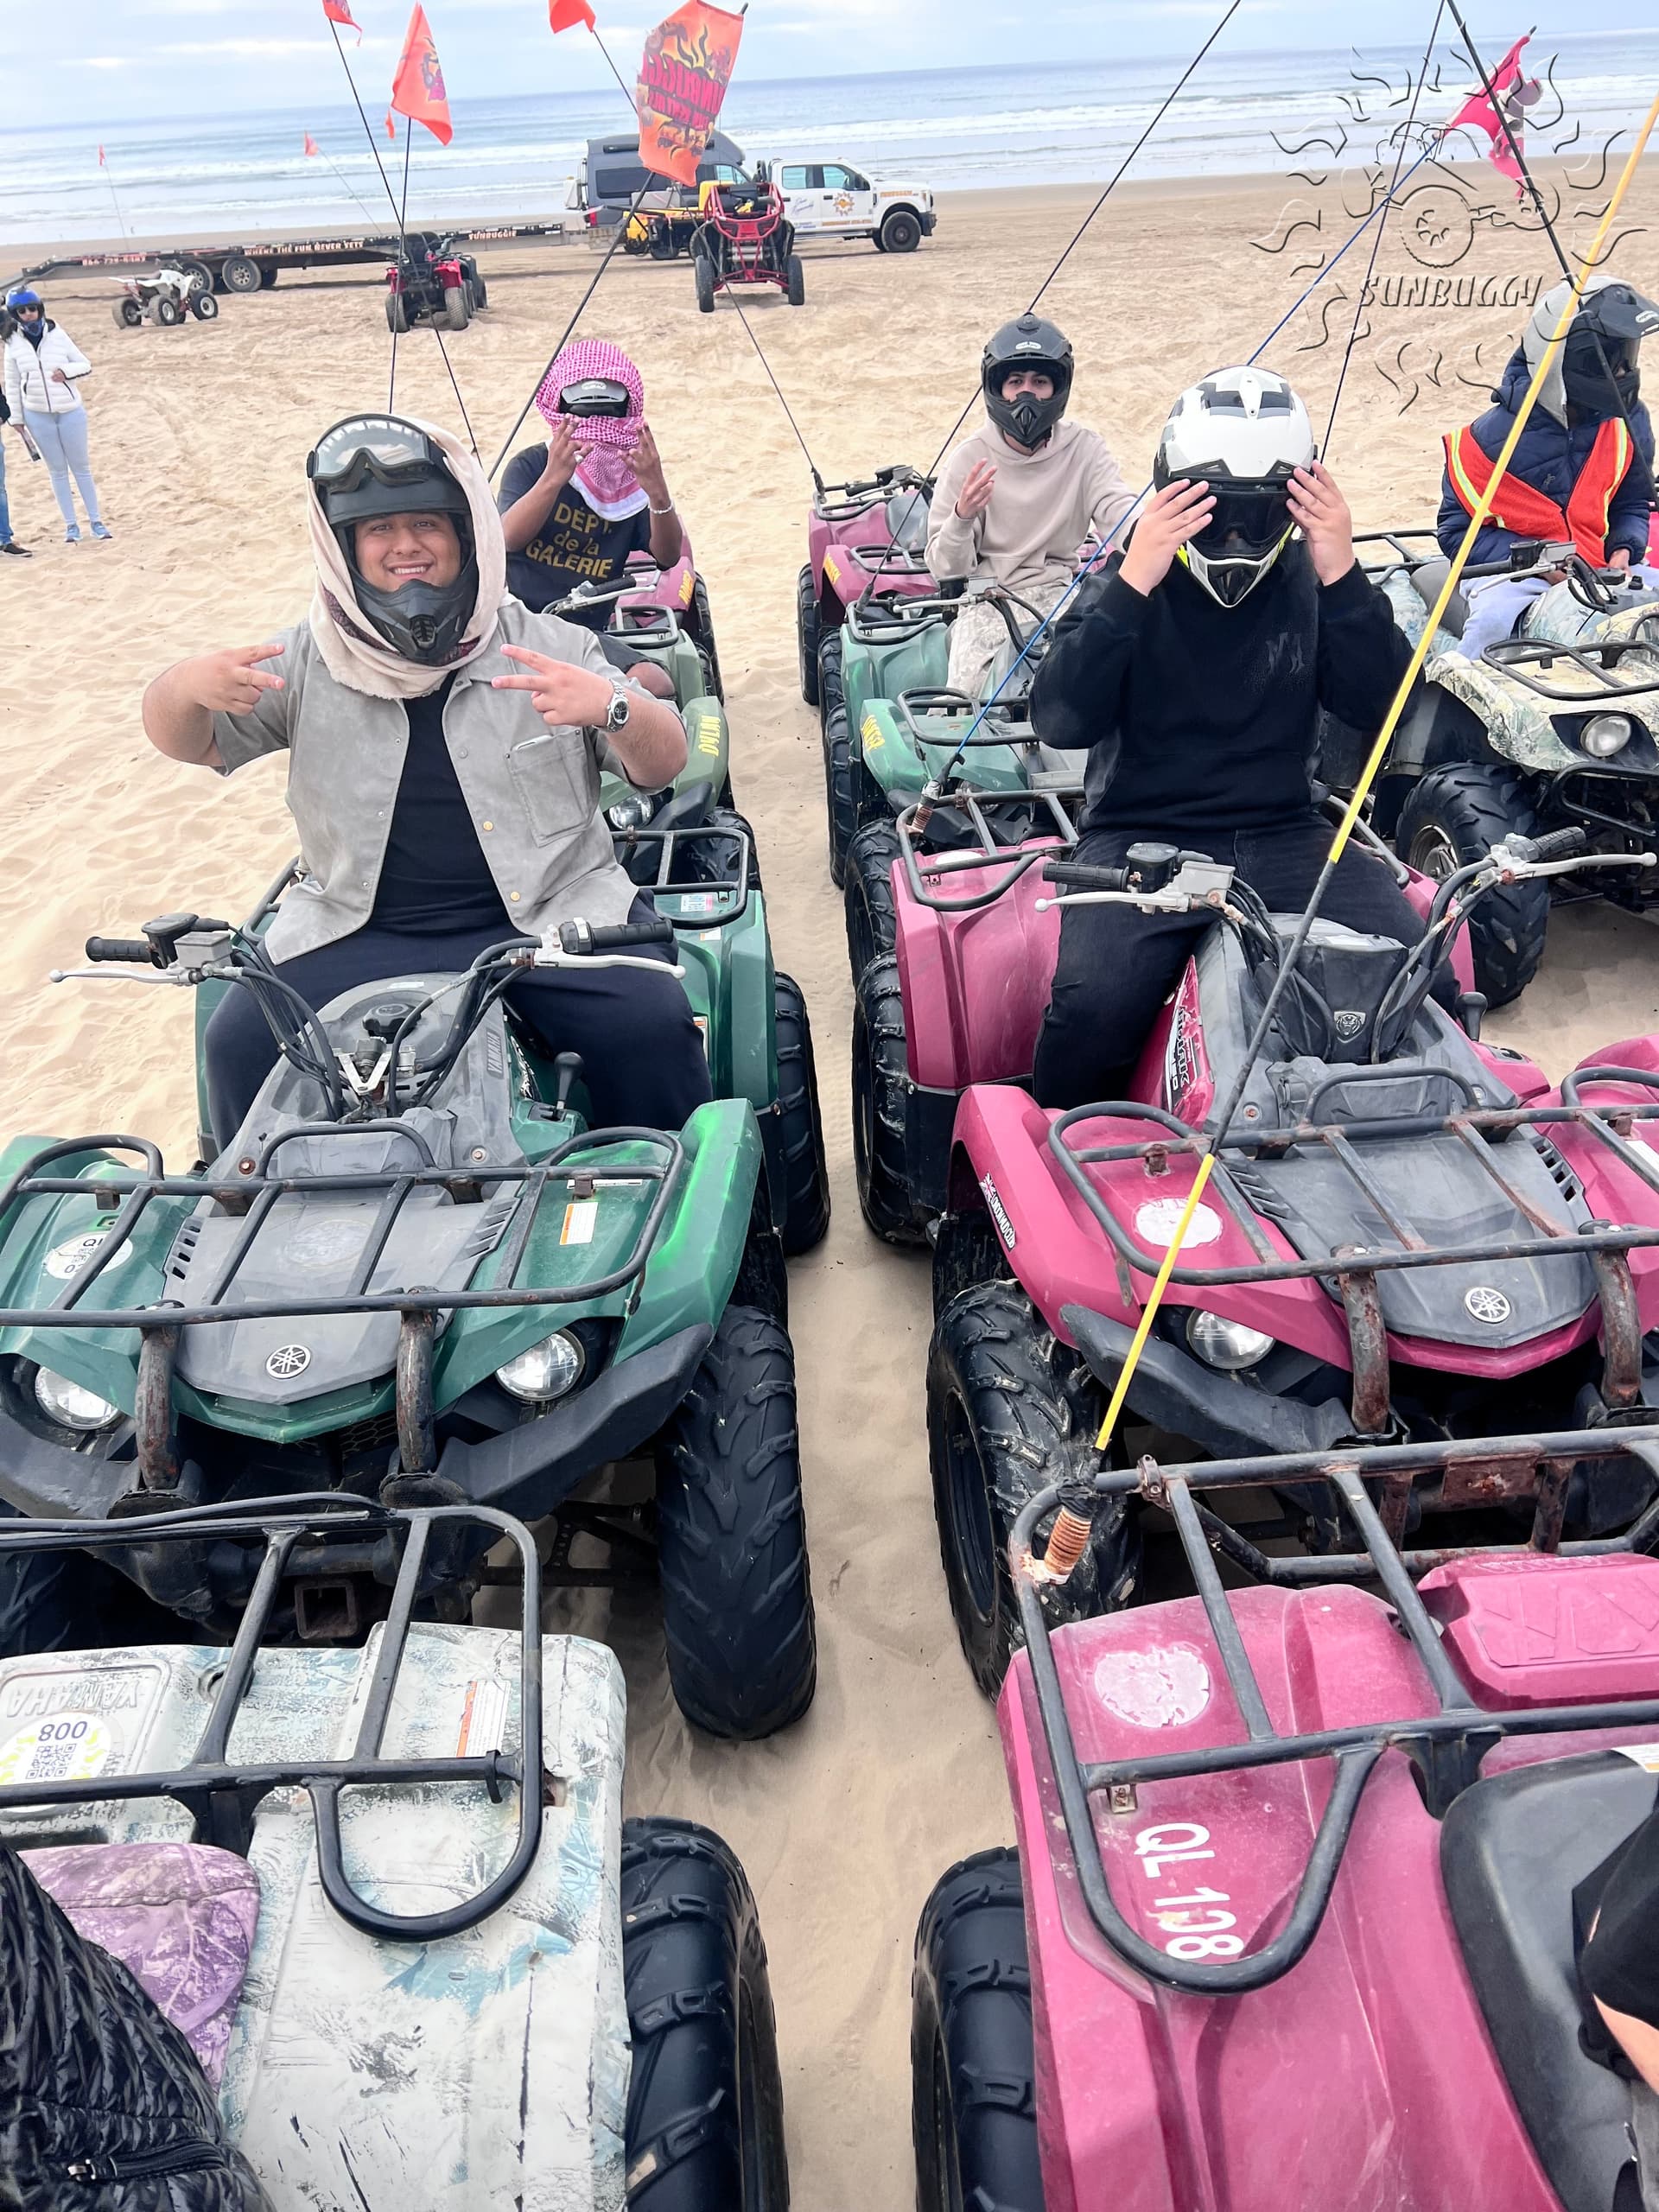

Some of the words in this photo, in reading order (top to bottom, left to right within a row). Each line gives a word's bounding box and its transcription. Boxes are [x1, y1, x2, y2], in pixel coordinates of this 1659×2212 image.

[525, 538, 613, 579] GALERIE
[554, 531, 579, 551] de
[582, 537, 600, 556] la
[7, 1680, 140, 1719] YAMAHA
[1134, 1822, 1216, 1878] QL
[1154, 1886, 1244, 1960] 108
